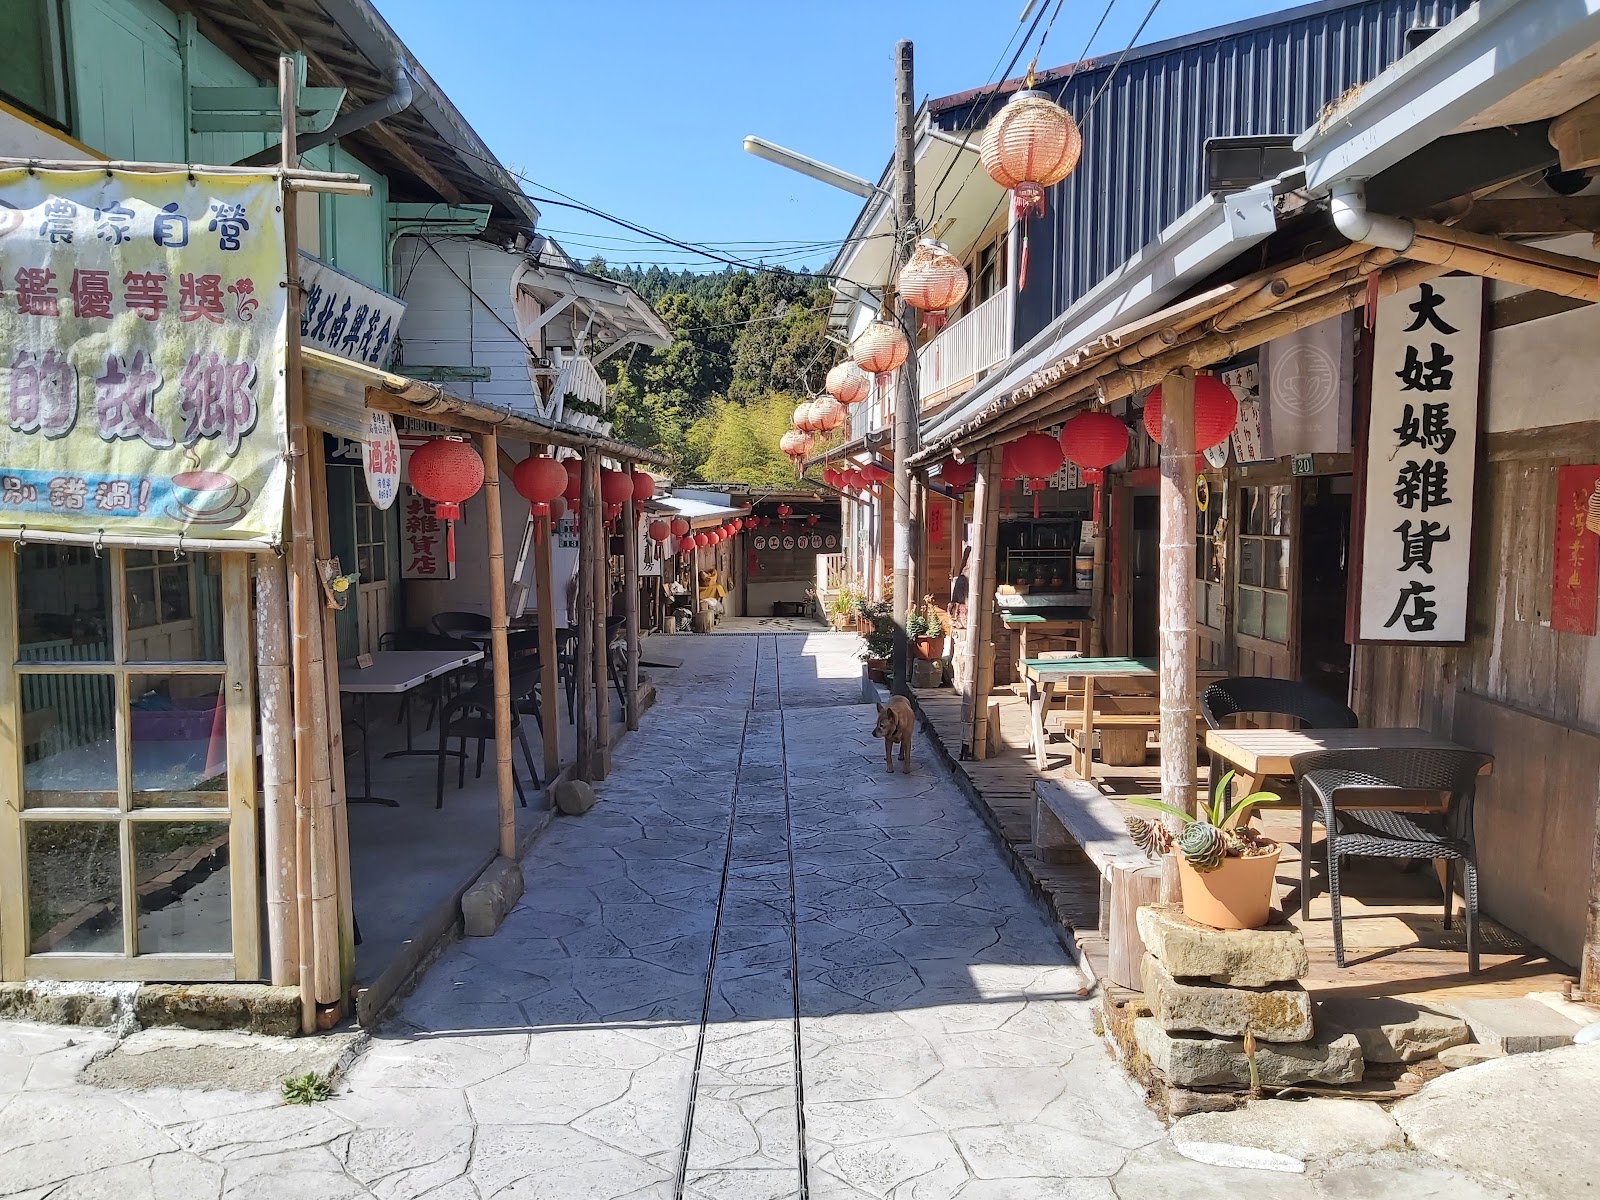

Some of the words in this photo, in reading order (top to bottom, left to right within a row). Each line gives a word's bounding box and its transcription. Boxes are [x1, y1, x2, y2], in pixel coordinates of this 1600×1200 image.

[40, 198, 249, 250] 農家自營
[0, 267, 225, 324] 鑑優等獎
[9, 348, 255, 454] 的故鄉
[1298, 459, 1309, 472] 20
[1384, 282, 1460, 633] 大姑媽雜貨店
[2, 475, 150, 512] 別錯過!
